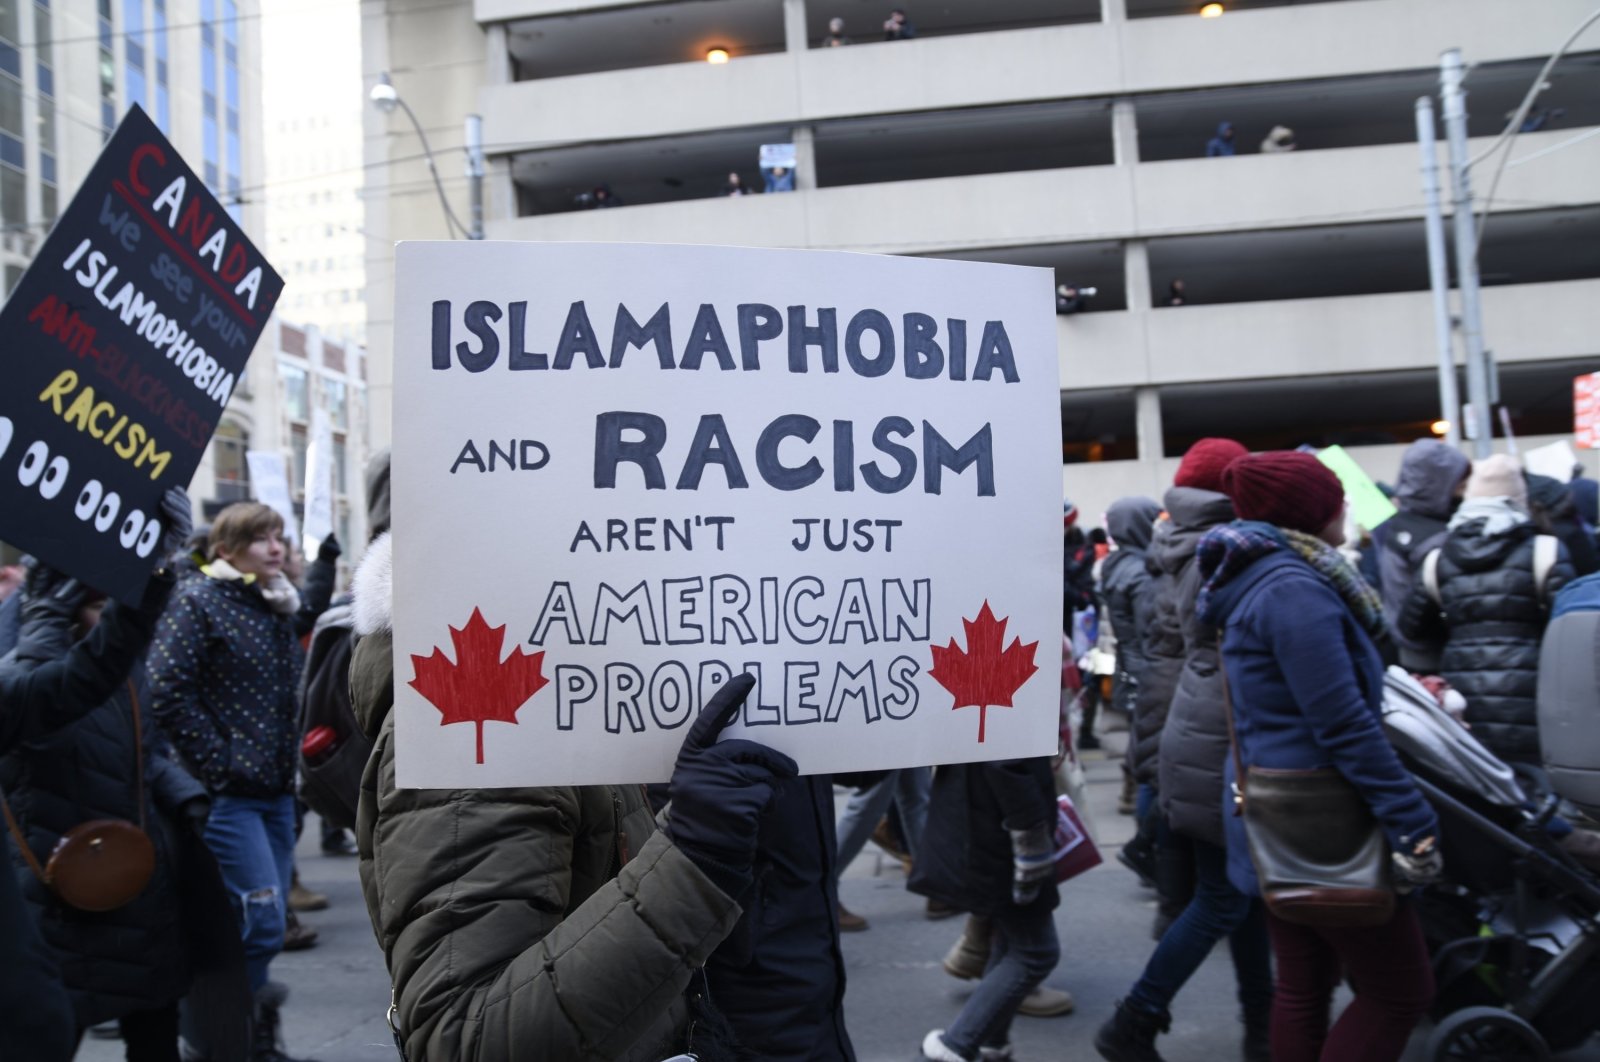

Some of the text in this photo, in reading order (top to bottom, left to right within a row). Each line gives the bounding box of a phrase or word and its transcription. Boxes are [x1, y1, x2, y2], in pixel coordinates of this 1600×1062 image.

[62, 238, 235, 408] ISLAMOPHOBIA
[150, 251, 195, 304] see
[191, 291, 248, 349] your
[431, 300, 1020, 383] ISLAMAPHOBIA
[28, 294, 210, 449] ANTI-BLACKNESS
[39, 368, 173, 480] RACISM
[450, 411, 996, 497] AND RACISM
[569, 514, 903, 552] AREN'T JUST
[528, 574, 931, 646] AMERICAN
